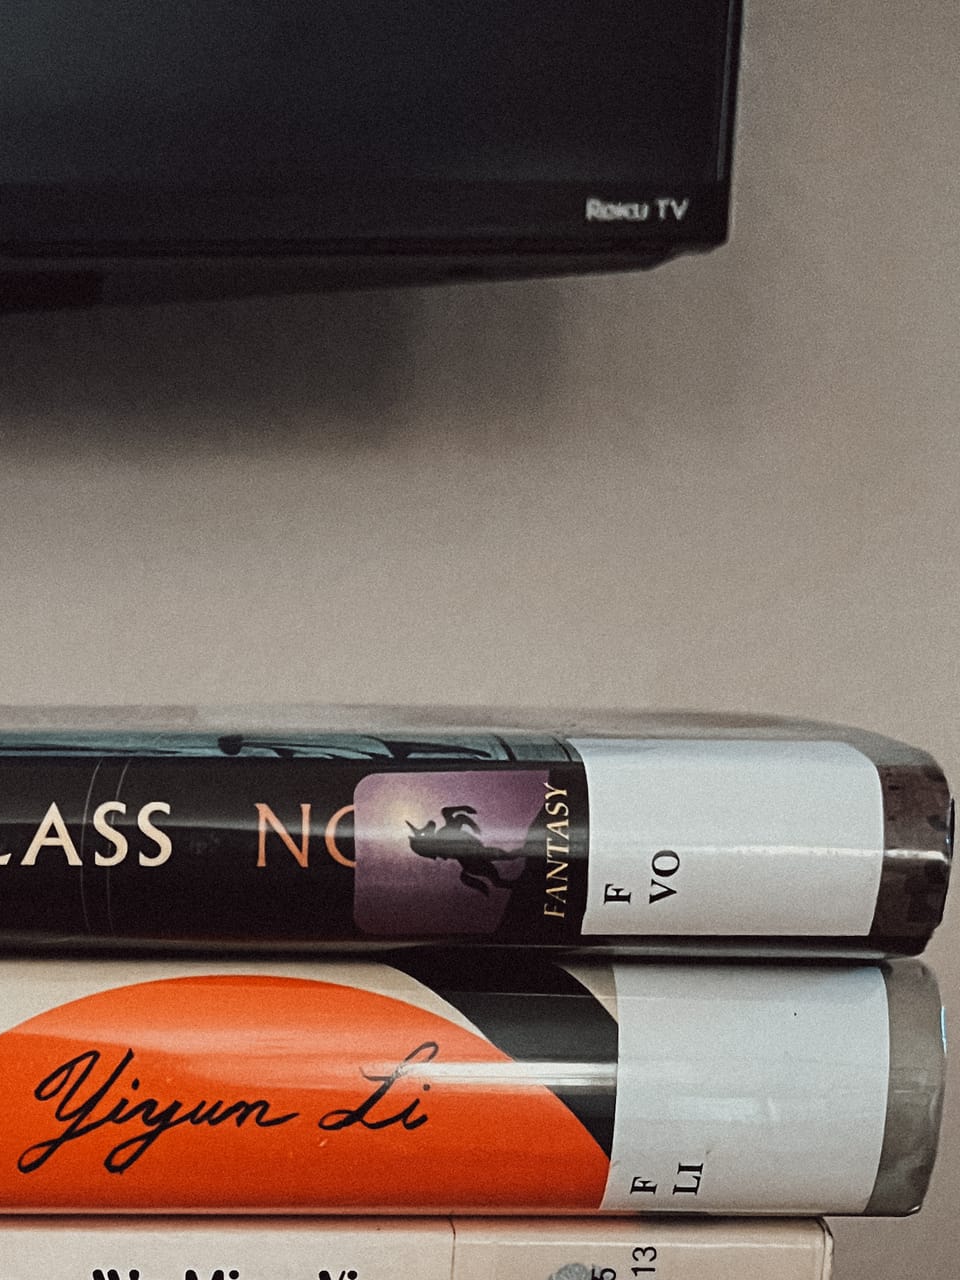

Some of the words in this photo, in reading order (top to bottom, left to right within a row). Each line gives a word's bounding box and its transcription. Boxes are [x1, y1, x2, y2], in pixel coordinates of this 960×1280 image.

[656, 198, 689, 220] TV
[543, 782, 570, 919] FANTASY
[603, 883, 632, 905] F
[648, 850, 681, 905] VO
[16, 1047, 299, 1175] Yiyun
[318, 1041, 440, 1132] Li
[630, 1175, 658, 1197] F
[671, 1161, 704, 1197] LI
